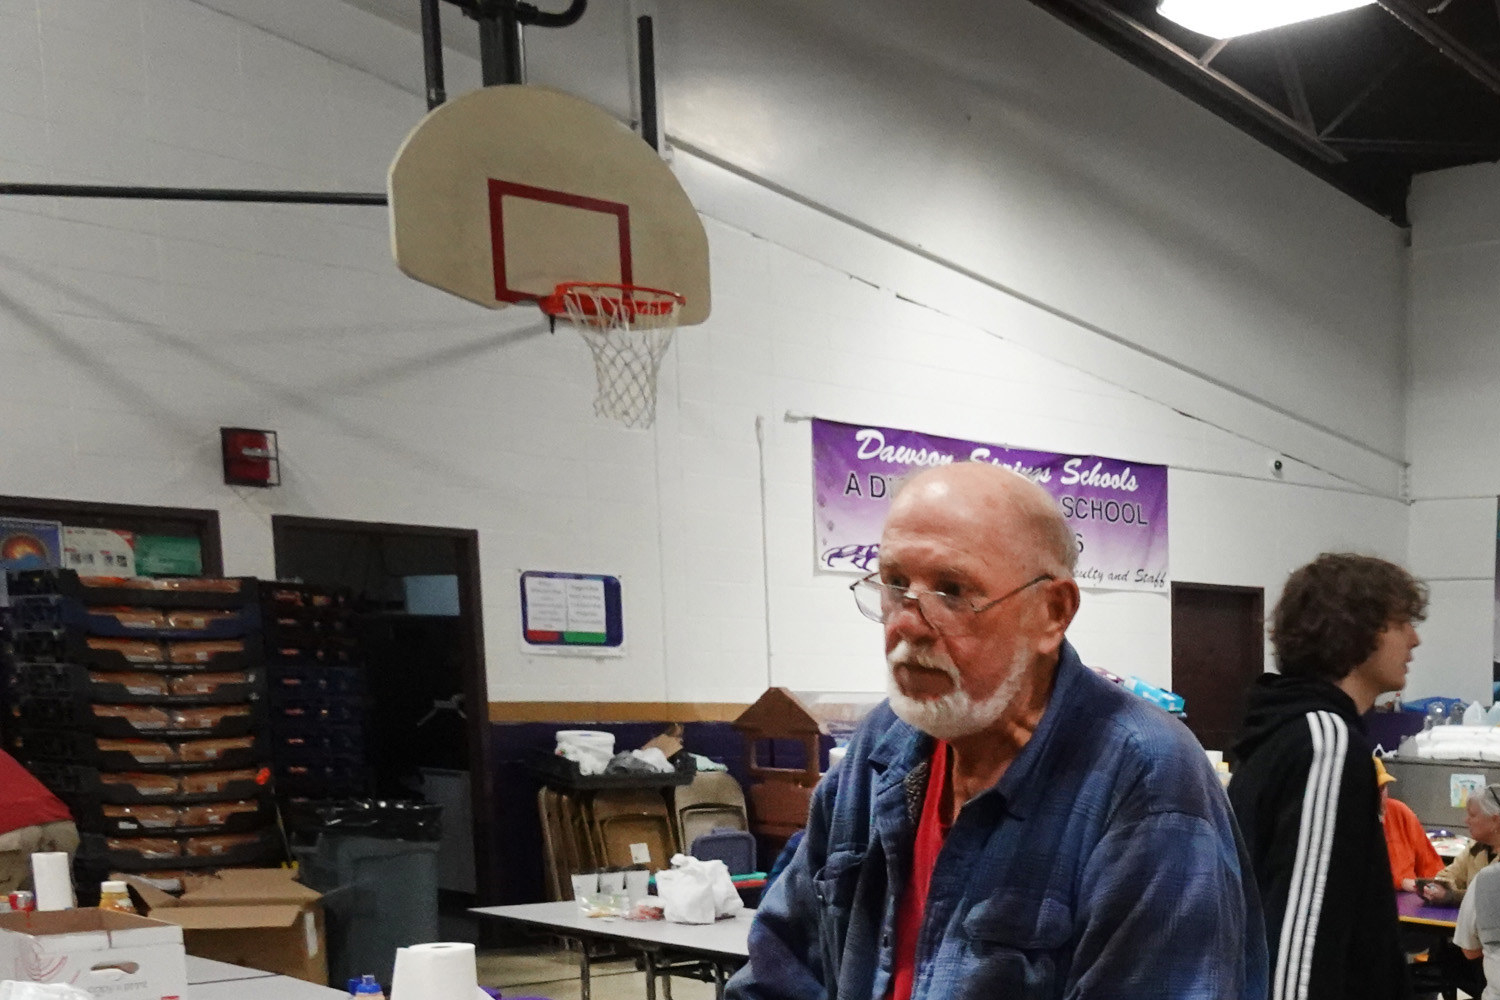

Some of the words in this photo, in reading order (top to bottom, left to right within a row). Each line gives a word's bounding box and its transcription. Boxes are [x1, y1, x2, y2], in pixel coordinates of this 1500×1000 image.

[855, 428, 954, 467] Dawson
[1060, 458, 1138, 492] Schools
[1062, 497, 1148, 525] SCHOOL
[1108, 570, 1130, 582] and
[1135, 568, 1167, 588] Staff
